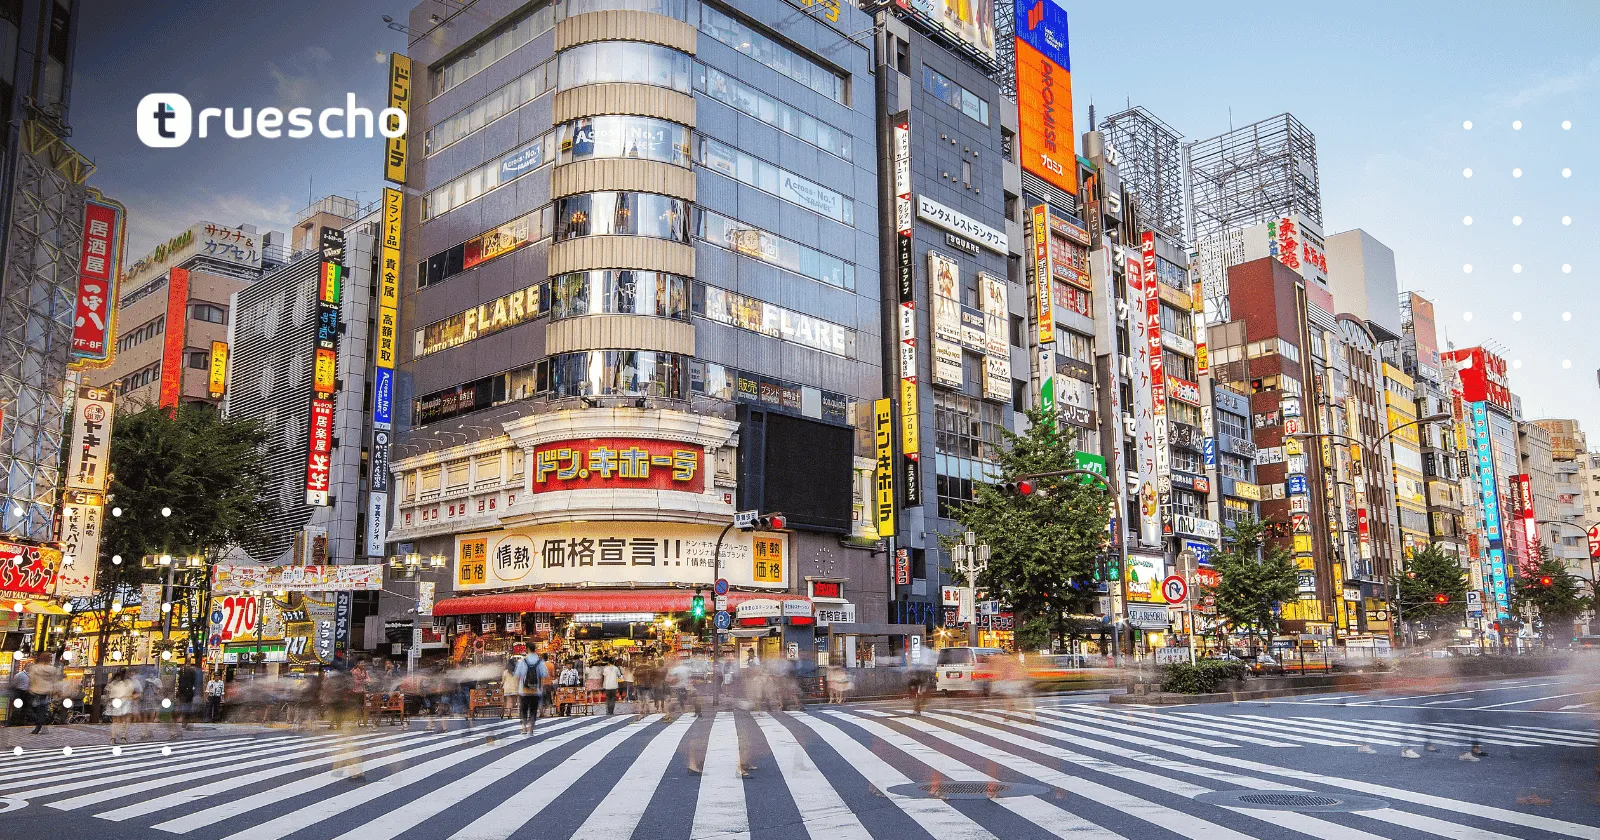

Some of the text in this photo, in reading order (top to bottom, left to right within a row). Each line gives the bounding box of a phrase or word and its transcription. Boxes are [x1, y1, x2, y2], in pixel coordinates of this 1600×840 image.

[1041, 59, 1057, 154] PROMISE
[1040, 153, 1064, 176] プロミス
[386, 193, 400, 247] ブランド品
[922, 202, 951, 223] エンタメ
[953, 215, 1006, 246] レストランタワー
[88, 218, 108, 274] 居酒屋
[203, 239, 261, 263] カプセル
[949, 235, 980, 254] SQUARE
[384, 258, 397, 298] 貴金属
[464, 286, 539, 337] FLARE
[380, 313, 395, 362] 高額買取
[763, 302, 846, 350] FLARE
[423, 342, 448, 356] PHOTO
[86, 390, 108, 402] 6F
[738, 377, 758, 394] 販売
[761, 385, 781, 396] ブランド
[81, 420, 103, 476] ヤキトリ
[1156, 418, 1166, 462] パーティー
[1203, 438, 1213, 465] 747
[878, 412, 892, 522] ドン・キホーテ
[76, 494, 99, 504] 5F
[463, 543, 485, 560] 情熱
[497, 545, 530, 570] 情熱
[686, 540, 748, 552] ドン・キホテグループの
[756, 541, 780, 557] 情熱
[462, 563, 485, 580] 価格
[756, 562, 781, 579] 価格
[1467, 593, 1477, 604] P
[222, 596, 257, 642] 270
[281, 610, 305, 621] カラオケ
[338, 593, 350, 633] カラオケ
[284, 636, 308, 655] 747
[321, 620, 332, 658] カラオケ
